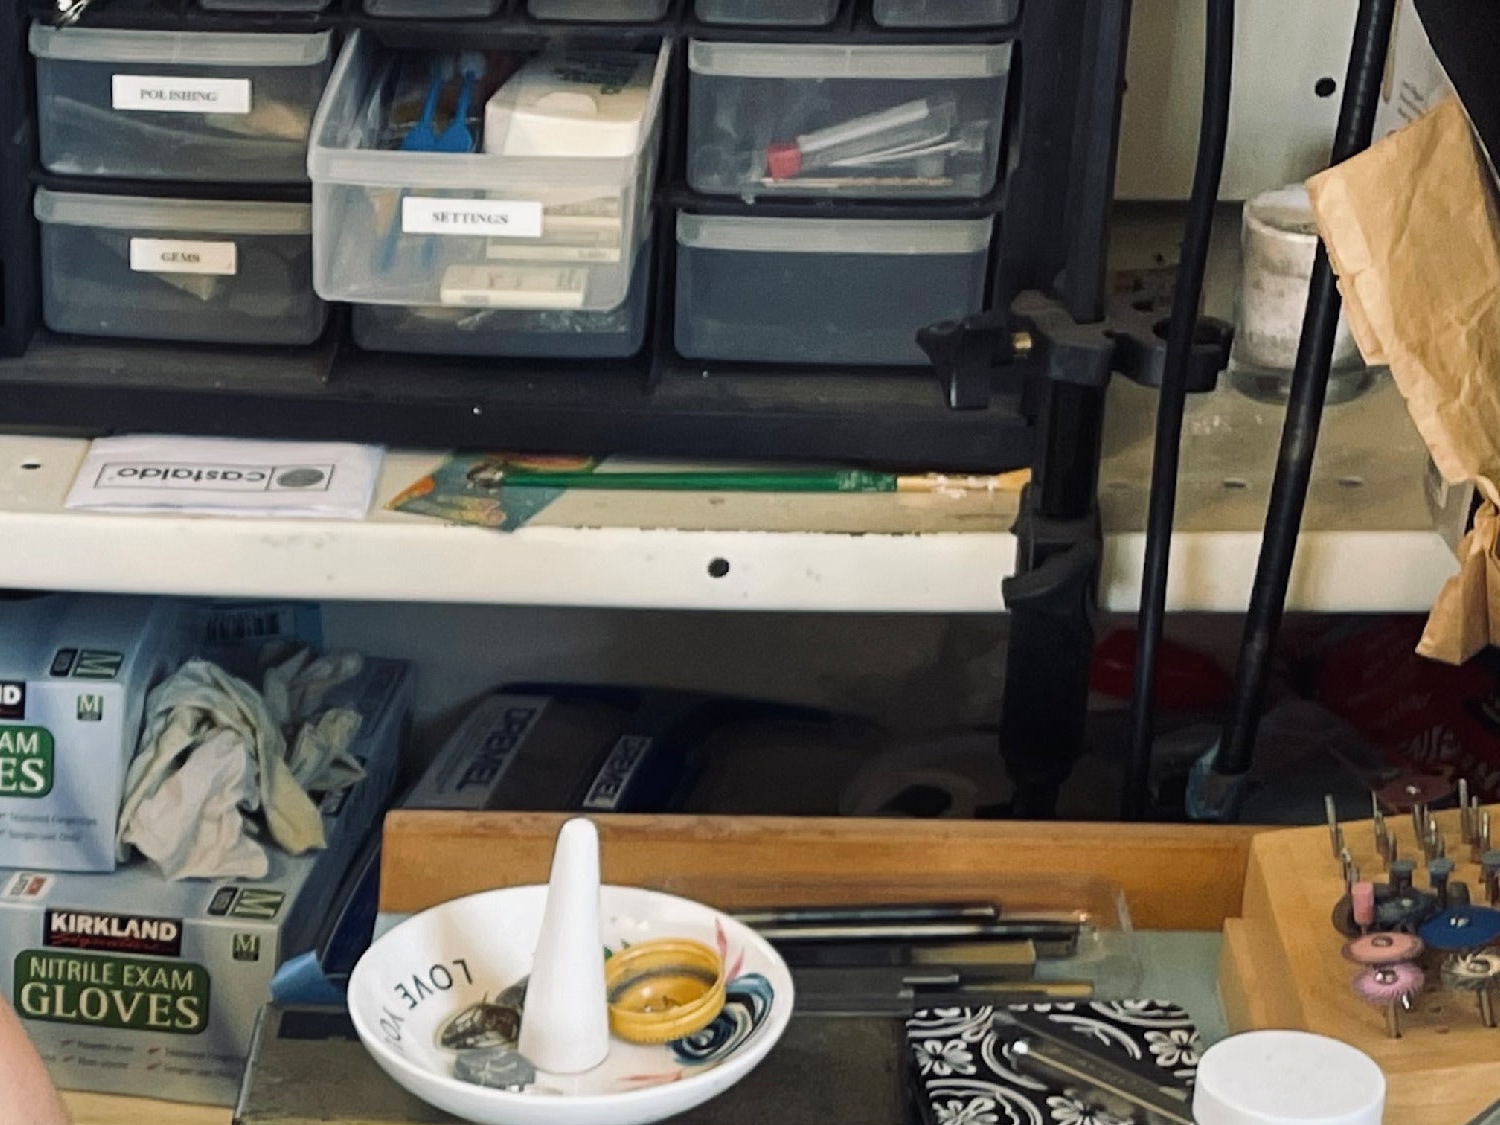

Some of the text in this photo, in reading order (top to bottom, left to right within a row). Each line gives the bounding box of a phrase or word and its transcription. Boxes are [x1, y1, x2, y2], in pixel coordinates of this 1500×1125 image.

[140, 89, 218, 102] POLISHING
[431, 211, 509, 225] SETTINGS
[160, 251, 200, 263] GEMS
[116, 467, 266, 483] castaldo
[78, 694, 100, 713] M
[51, 912, 177, 942] KIRKLAND
[235, 936, 256, 952] M
[30, 957, 193, 991] NITRILE EXAM
[394, 958, 473, 1009] LOVE
[21, 981, 200, 1029] GLOVES
